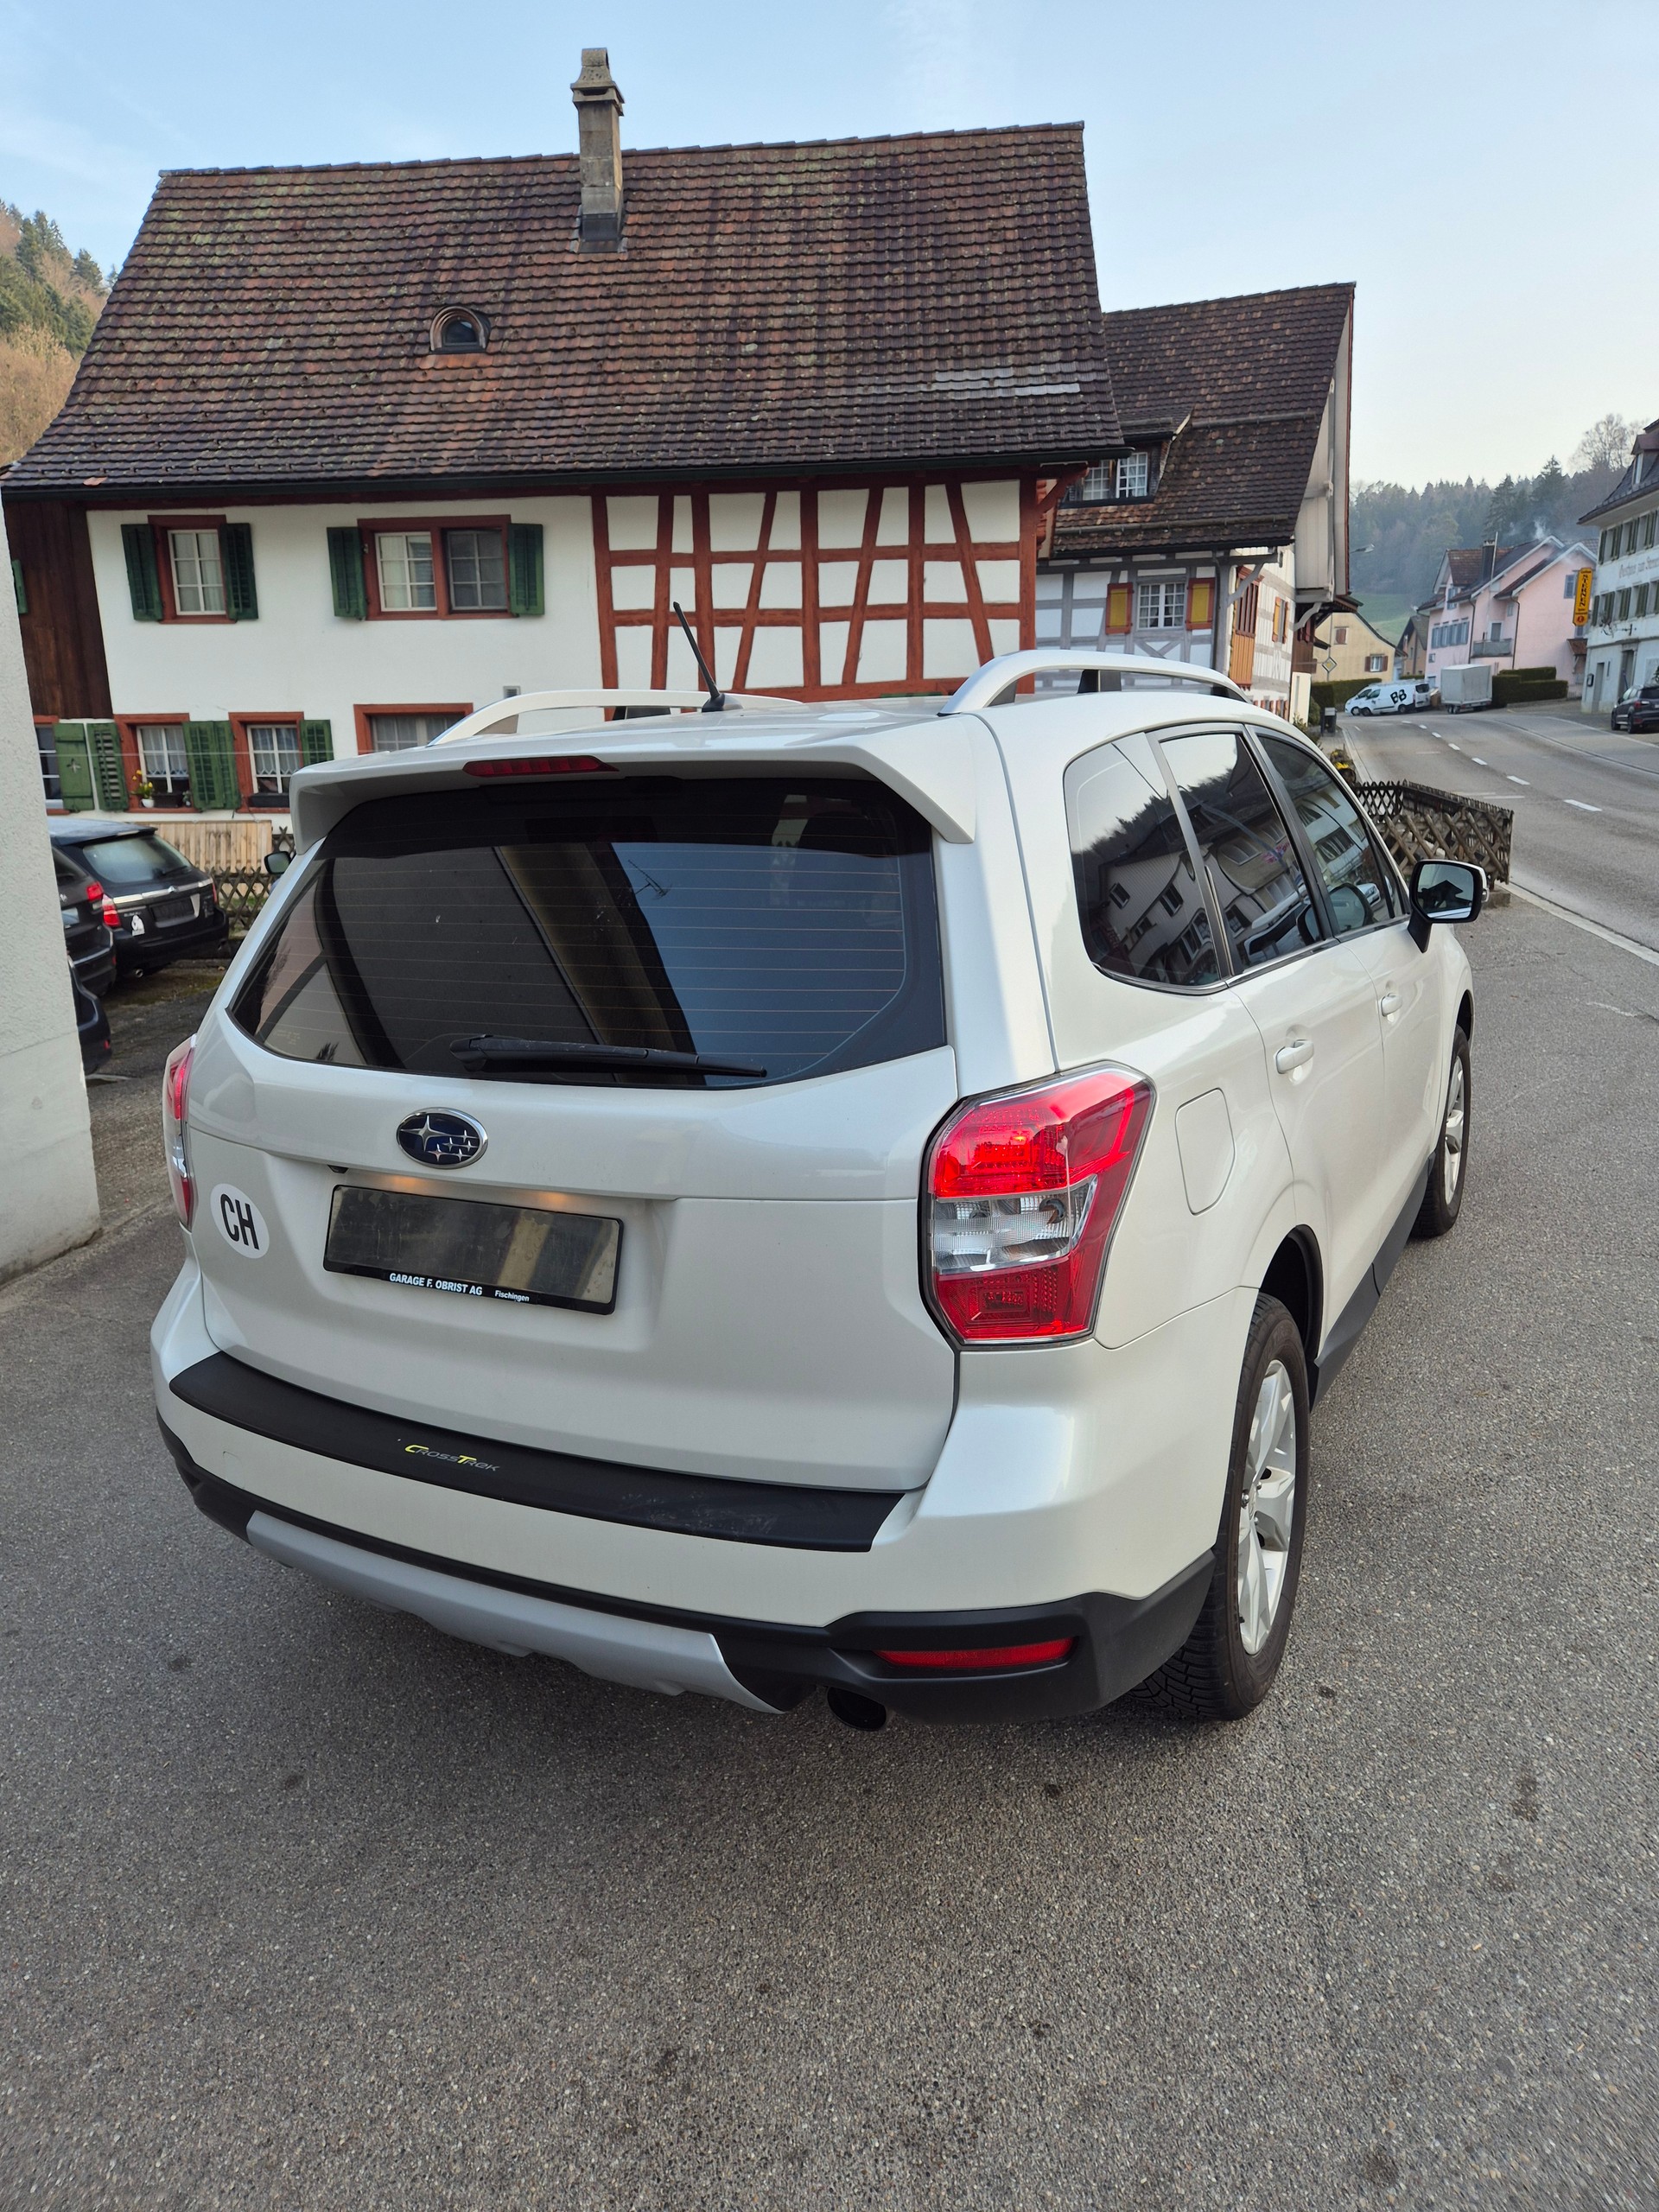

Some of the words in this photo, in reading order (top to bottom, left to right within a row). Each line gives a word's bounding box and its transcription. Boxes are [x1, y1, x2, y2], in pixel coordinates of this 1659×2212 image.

[220, 1193, 260, 1250] CH
[390, 1273, 425, 1287] GARAGE
[427, 1279, 433, 1287] F.
[435, 1280, 468, 1294] OBRIST
[469, 1286, 483, 1296] AG
[494, 1289, 530, 1302] Fischingen
